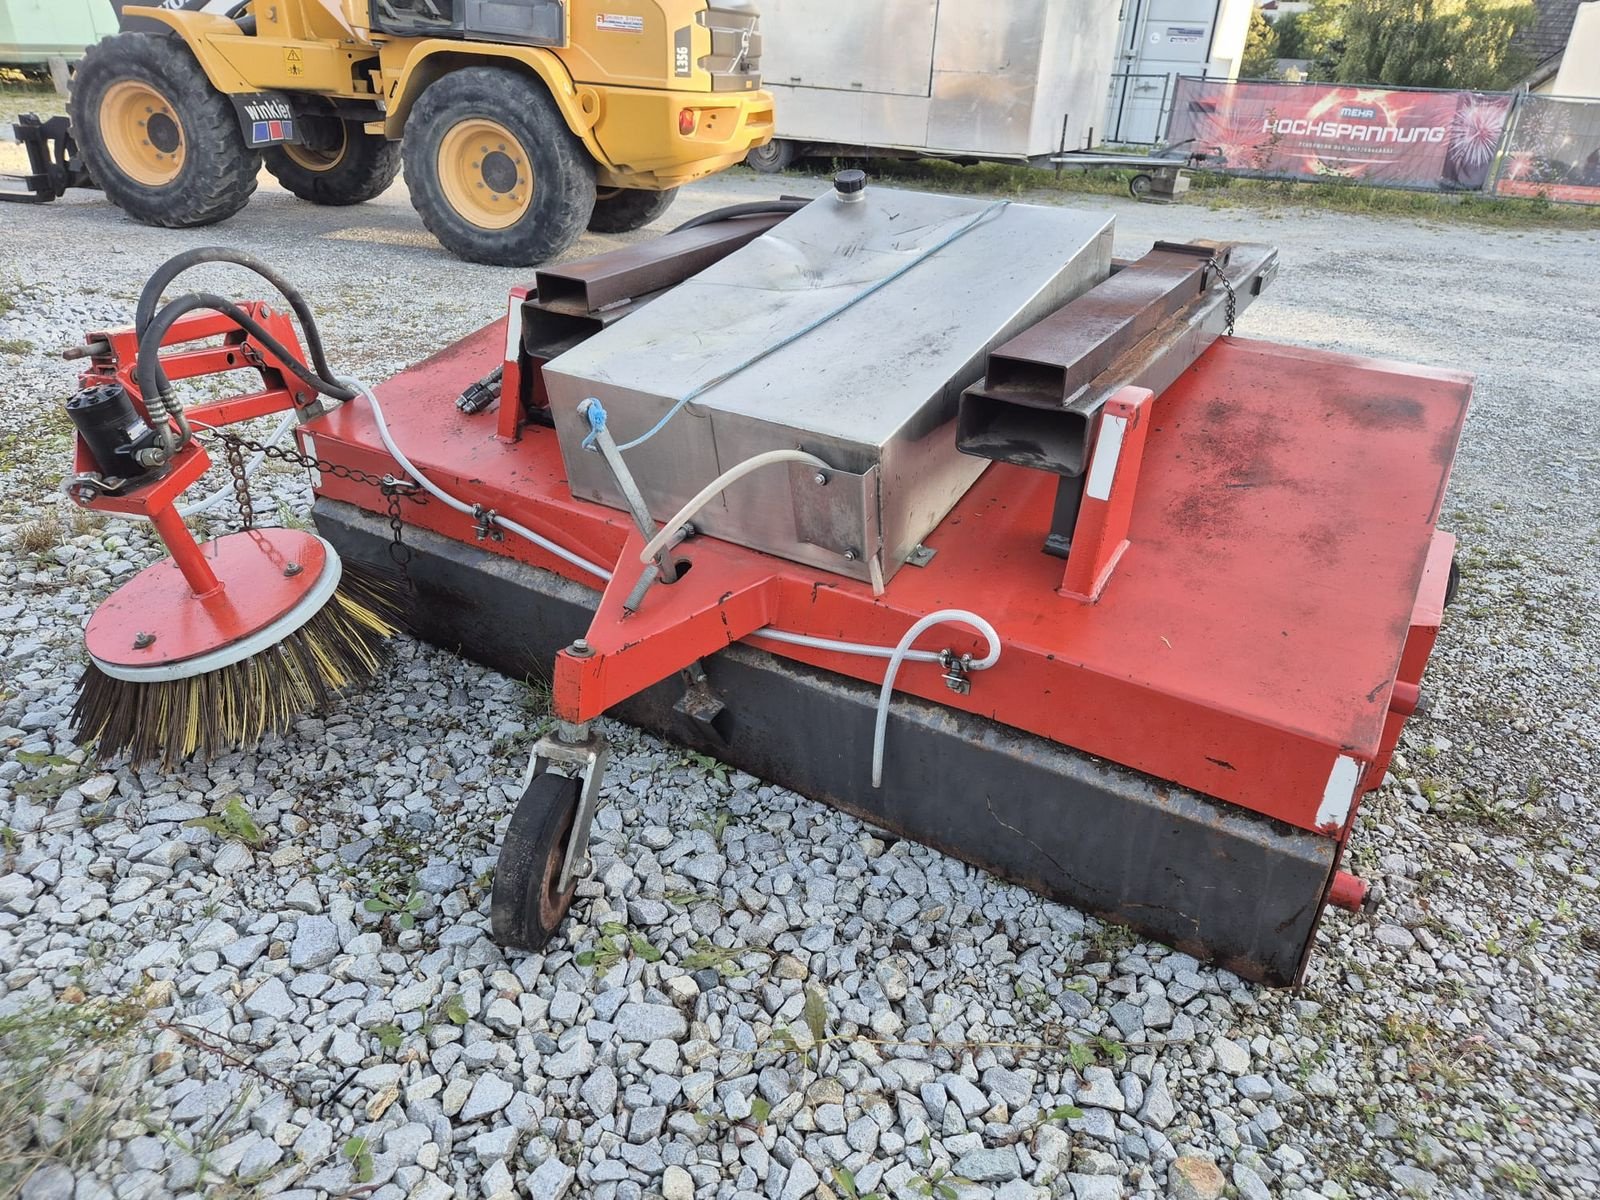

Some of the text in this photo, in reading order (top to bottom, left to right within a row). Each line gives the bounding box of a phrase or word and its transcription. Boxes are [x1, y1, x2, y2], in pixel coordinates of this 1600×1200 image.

[244, 99, 291, 120] winkler
[1340, 107, 1375, 118] MEHR
[1262, 119, 1446, 144] HOCHSPANNUNG
